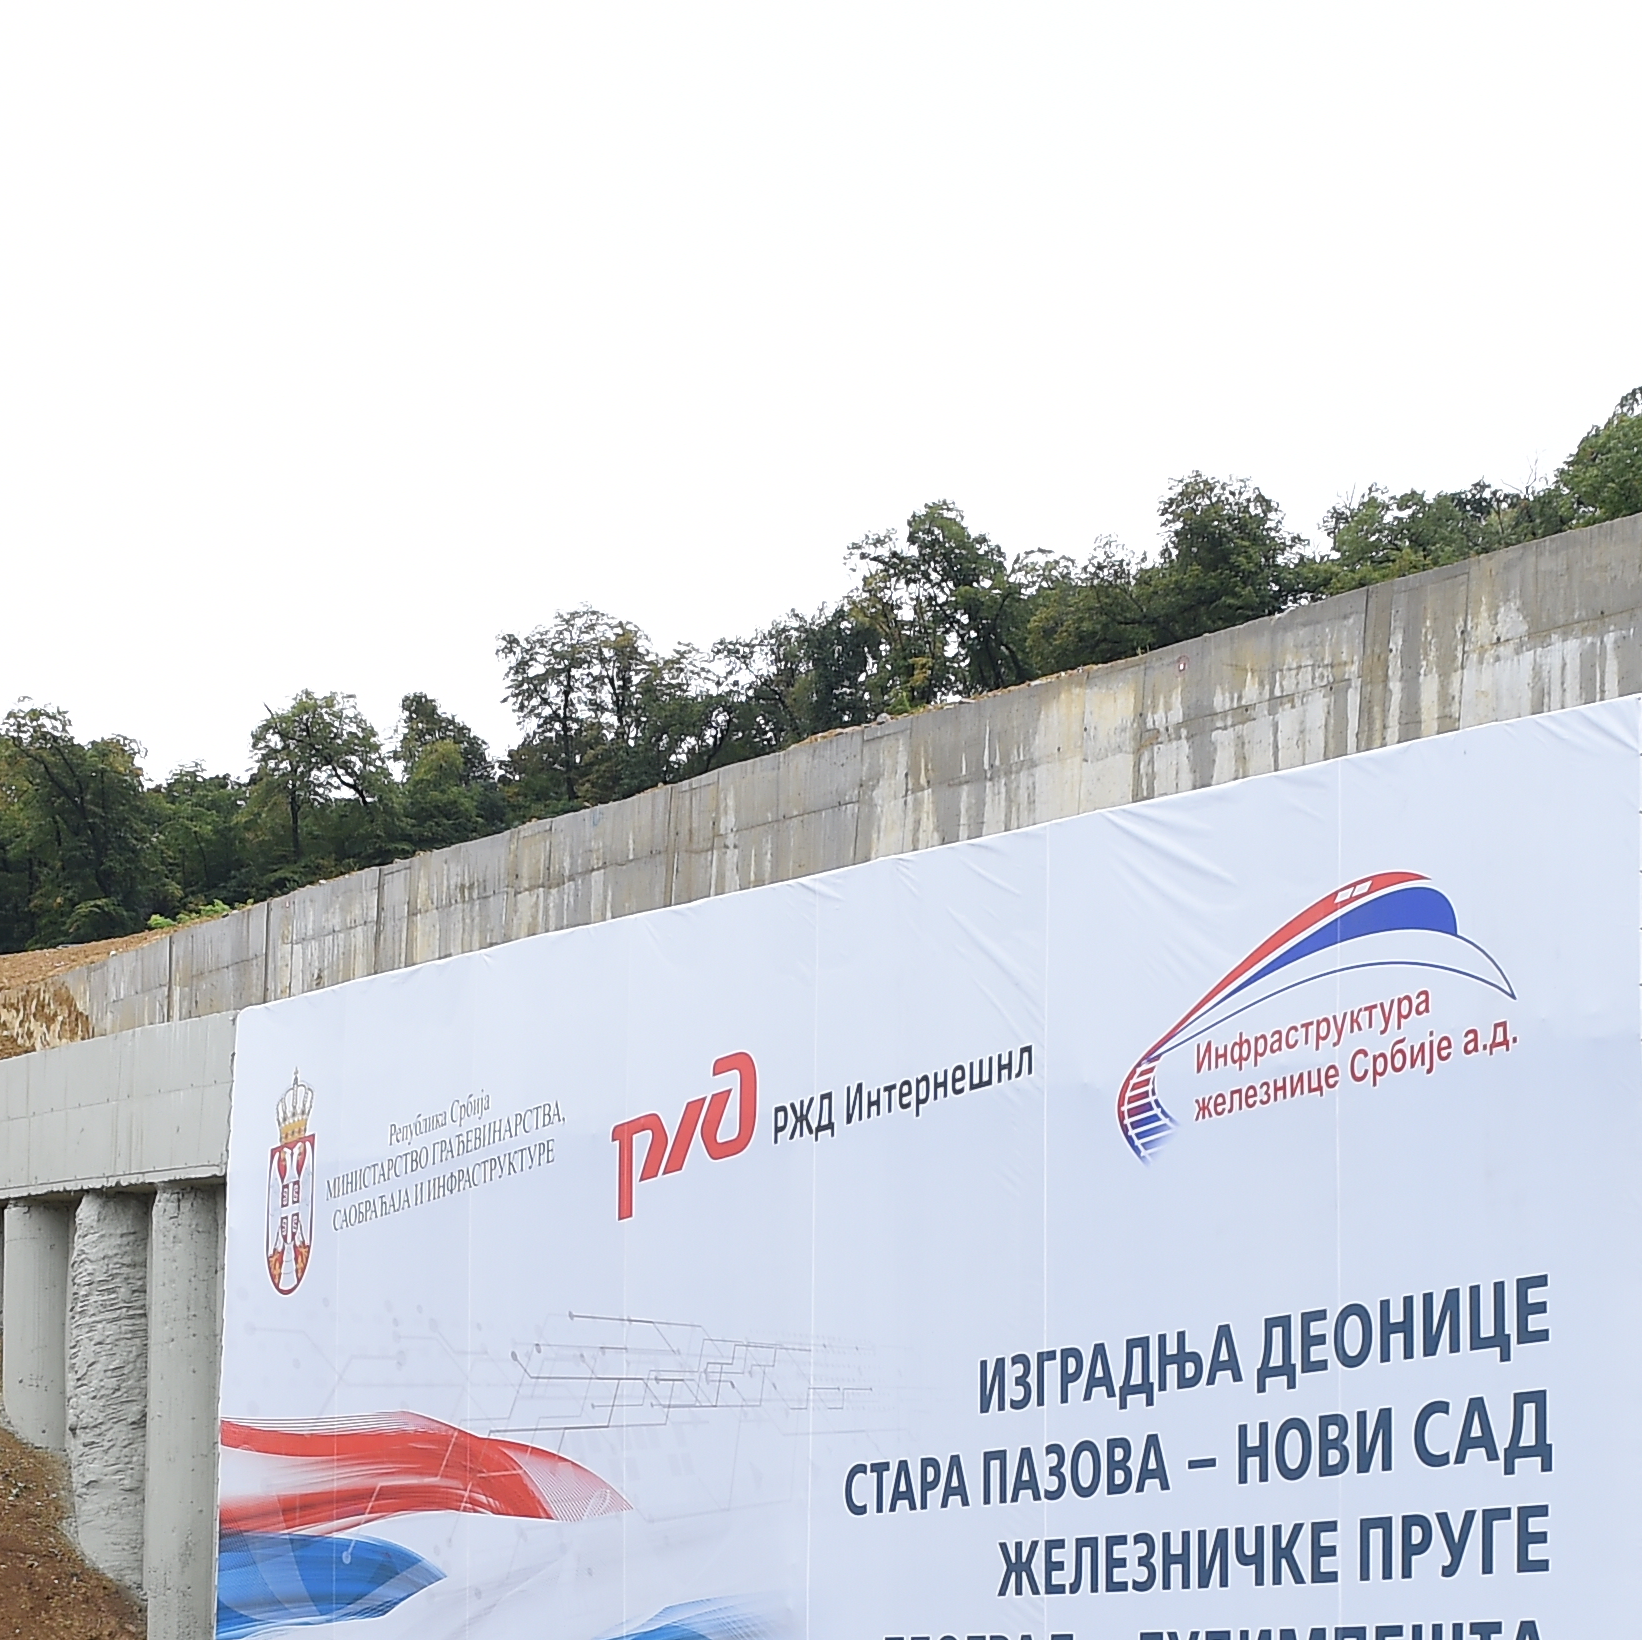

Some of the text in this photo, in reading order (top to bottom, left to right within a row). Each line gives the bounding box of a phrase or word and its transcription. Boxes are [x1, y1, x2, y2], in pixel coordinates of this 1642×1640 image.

[1193, 1015, 1519, 1123] железнице Србије а.д.
[1194, 987, 1432, 1075] Инфраструктура
[388, 1089, 490, 1146] Република Србија
[771, 1044, 1034, 1146] РЖД Интернешнл
[325, 1146, 429, 1201] МИНИСТАРСТВО
[332, 1138, 556, 1232] САОБРАЋАЈА И ИНФРАСТРУКТУРЕ
[978, 1272, 1551, 1414] ИЗГРАДЊА ДЕОНИЦЕ
[845, 1453, 971, 1516] СТАРА
[981, 1433, 1170, 1506] ПАЗОВА
[1236, 1408, 1393, 1486] НОВИ
[1413, 1389, 1553, 1475] САД
[996, 1504, 1551, 1598] ЖЕЛЕЗНИЧКЕ ПРУГЕ
